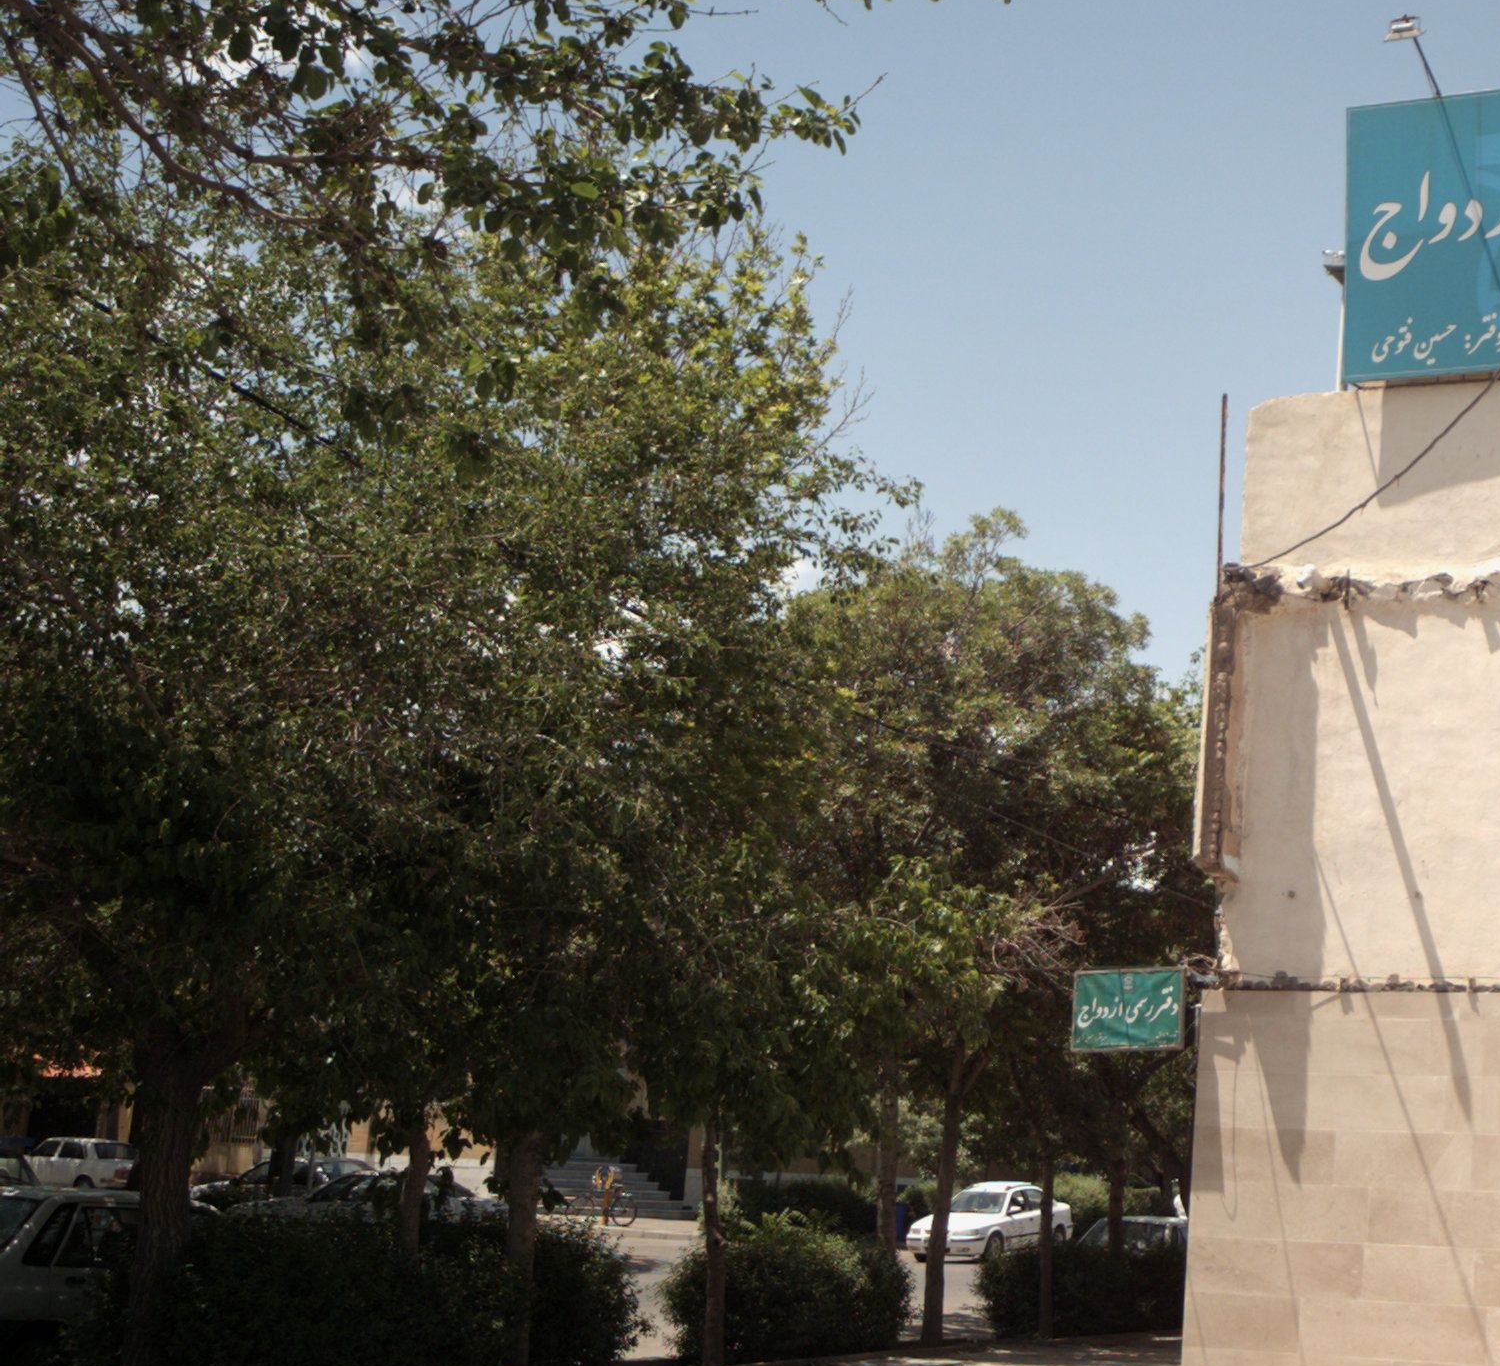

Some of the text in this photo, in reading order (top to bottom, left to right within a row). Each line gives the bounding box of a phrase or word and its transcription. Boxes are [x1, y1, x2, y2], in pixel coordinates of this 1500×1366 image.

[1371, 316, 1414, 364] فتوحی
[1413, 323, 1457, 365] حسین
[1076, 986, 1179, 1028] دفتر رسمی ازدواج
